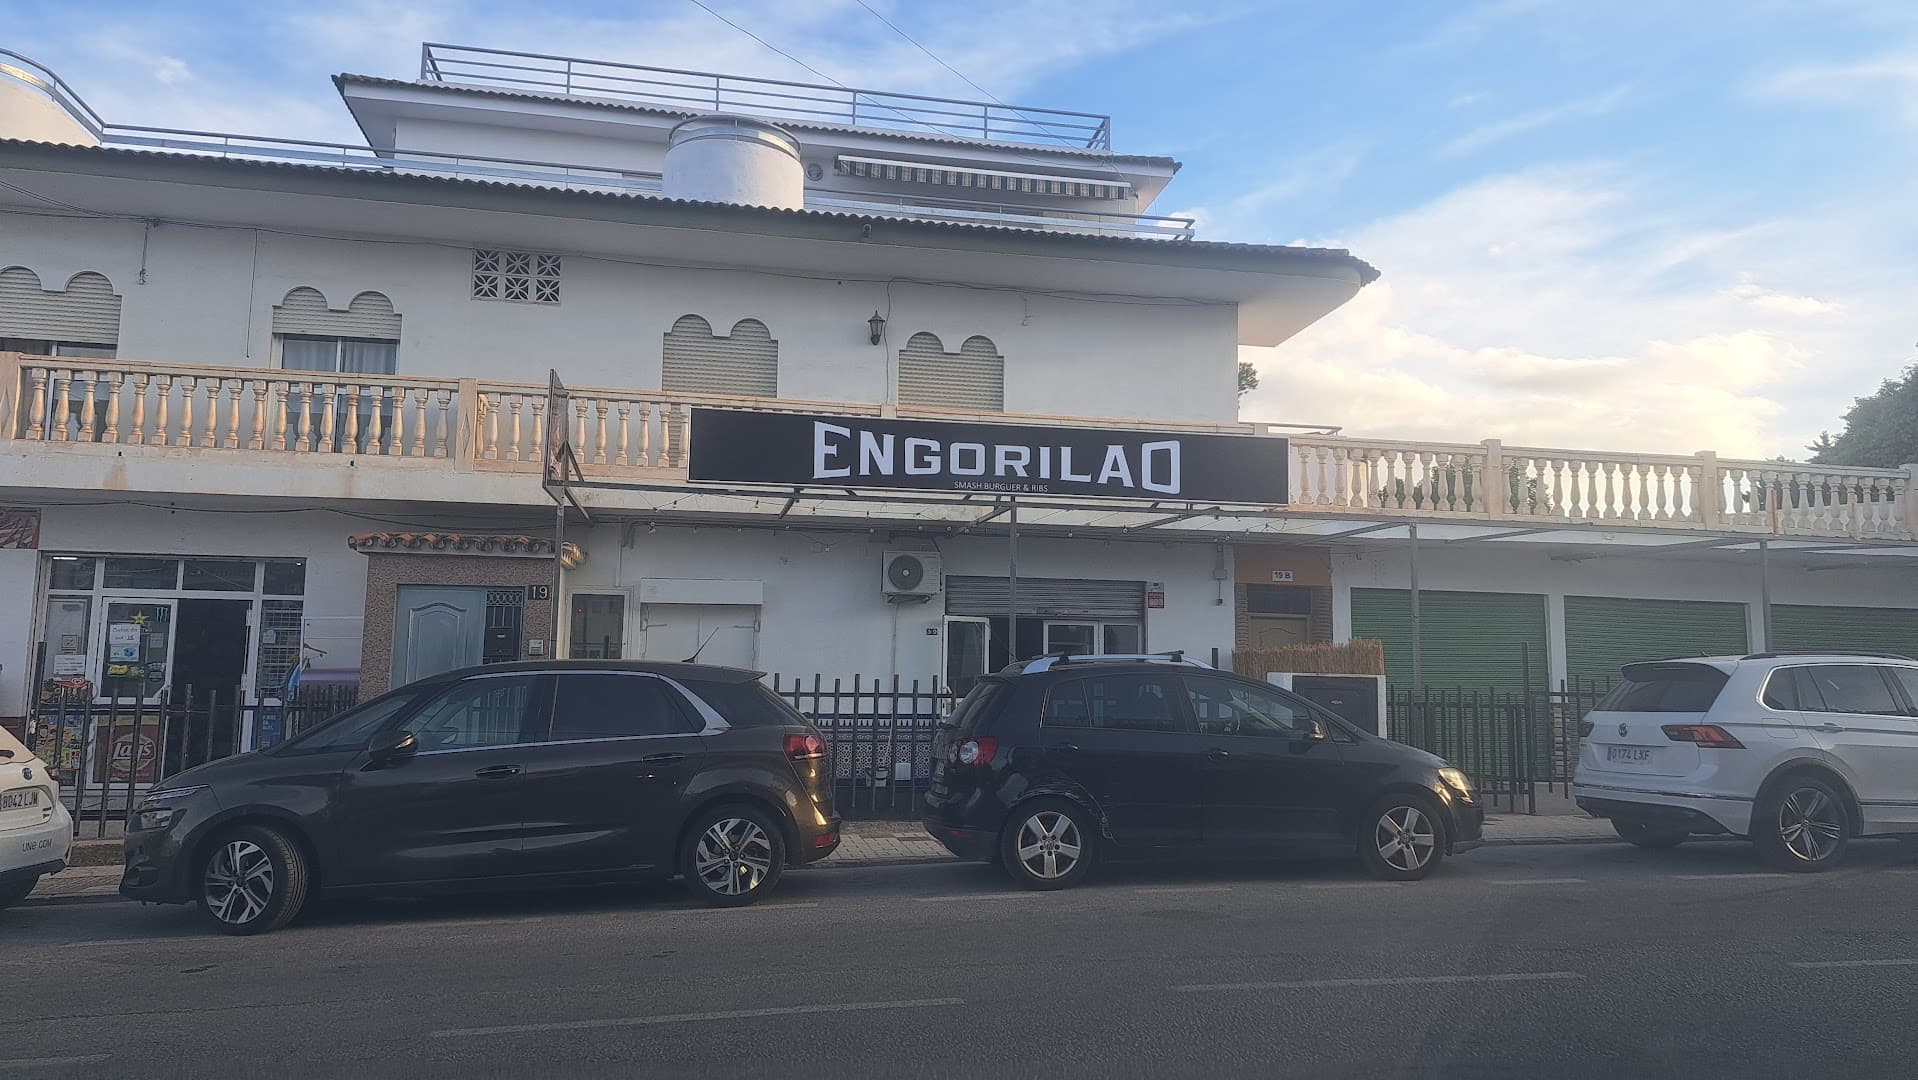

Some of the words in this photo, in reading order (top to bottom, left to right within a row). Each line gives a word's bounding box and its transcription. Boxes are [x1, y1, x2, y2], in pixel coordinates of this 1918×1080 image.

[812, 420, 1181, 495] ENGORILAO
[954, 480, 982, 490] SMASH
[983, 482, 1021, 492] BURGUER
[1022, 483, 1030, 492] &
[1031, 484, 1049, 493] RIBS
[533, 585, 548, 599] 19
